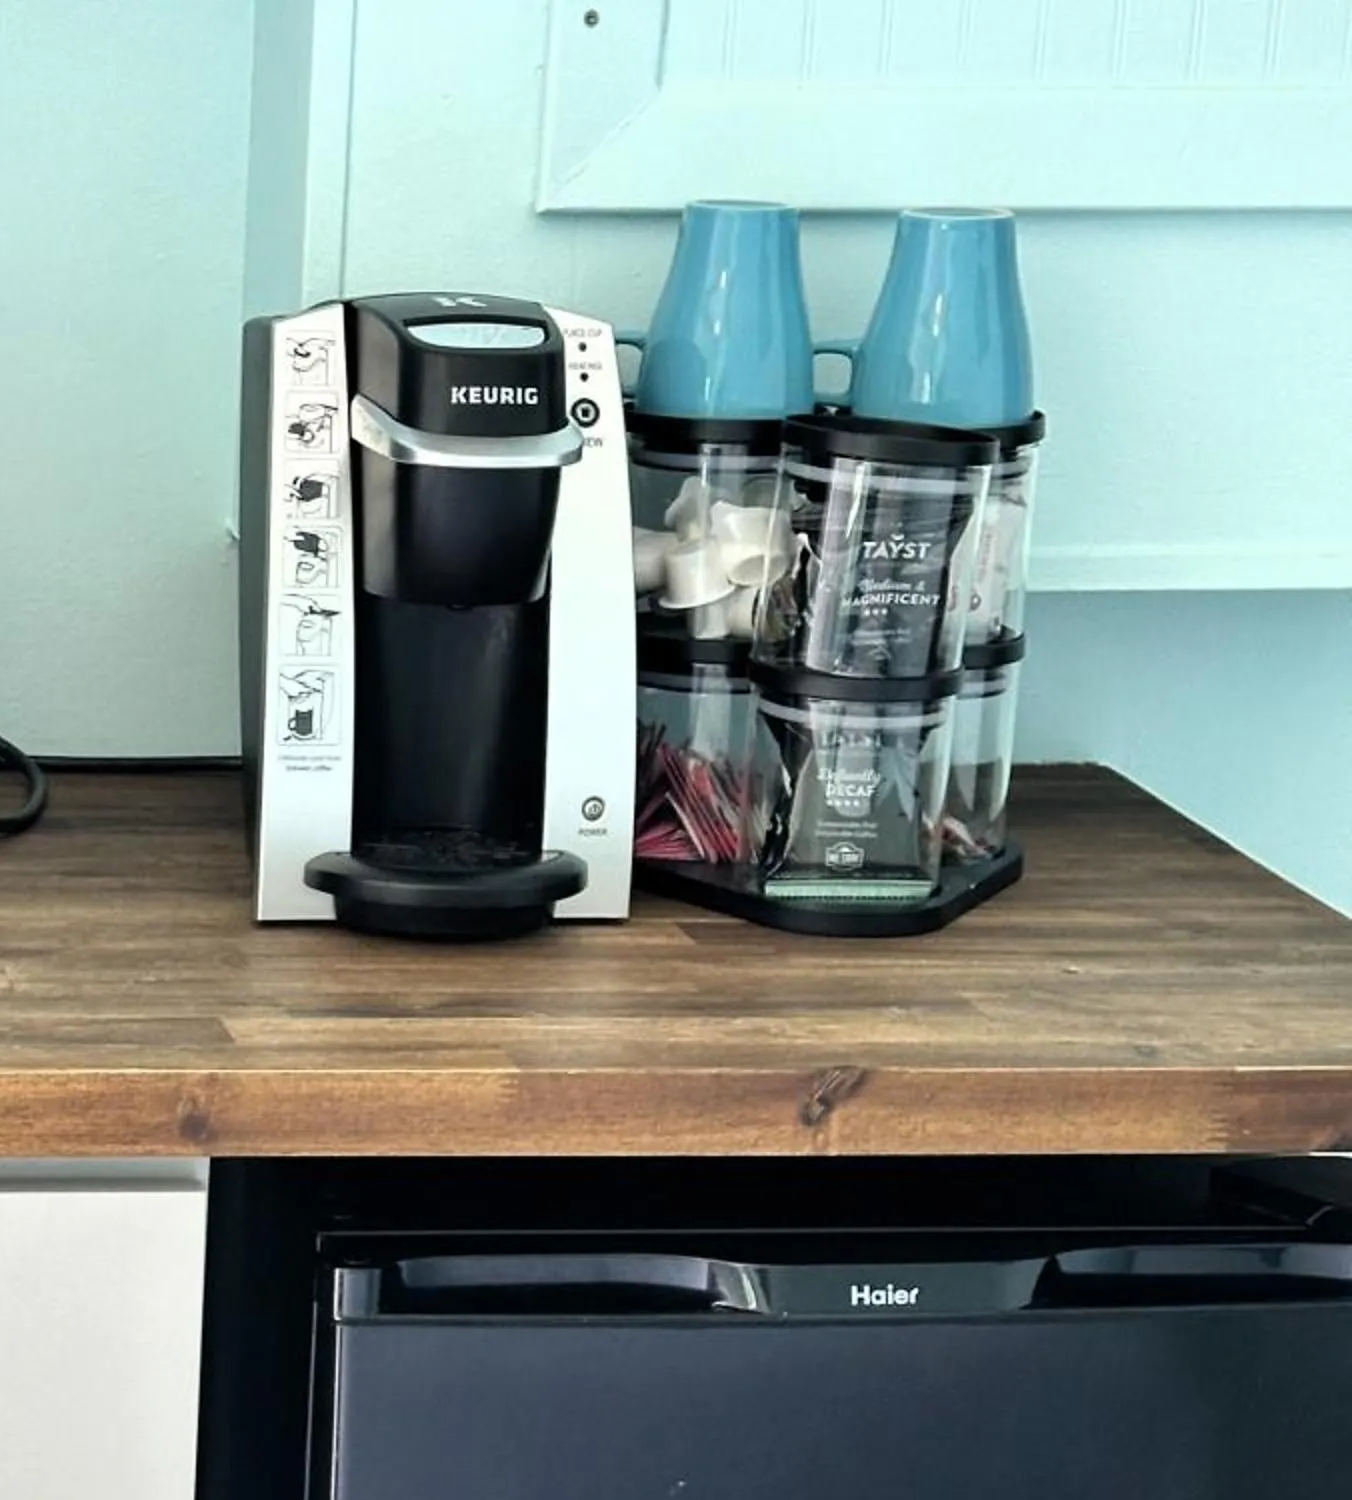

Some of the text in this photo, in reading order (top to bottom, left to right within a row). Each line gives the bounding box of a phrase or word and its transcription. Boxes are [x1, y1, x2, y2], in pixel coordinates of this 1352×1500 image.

[451, 386, 539, 405] KEURIG
[826, 782, 876, 798] DECAF
[851, 1284, 919, 1306] Haier
